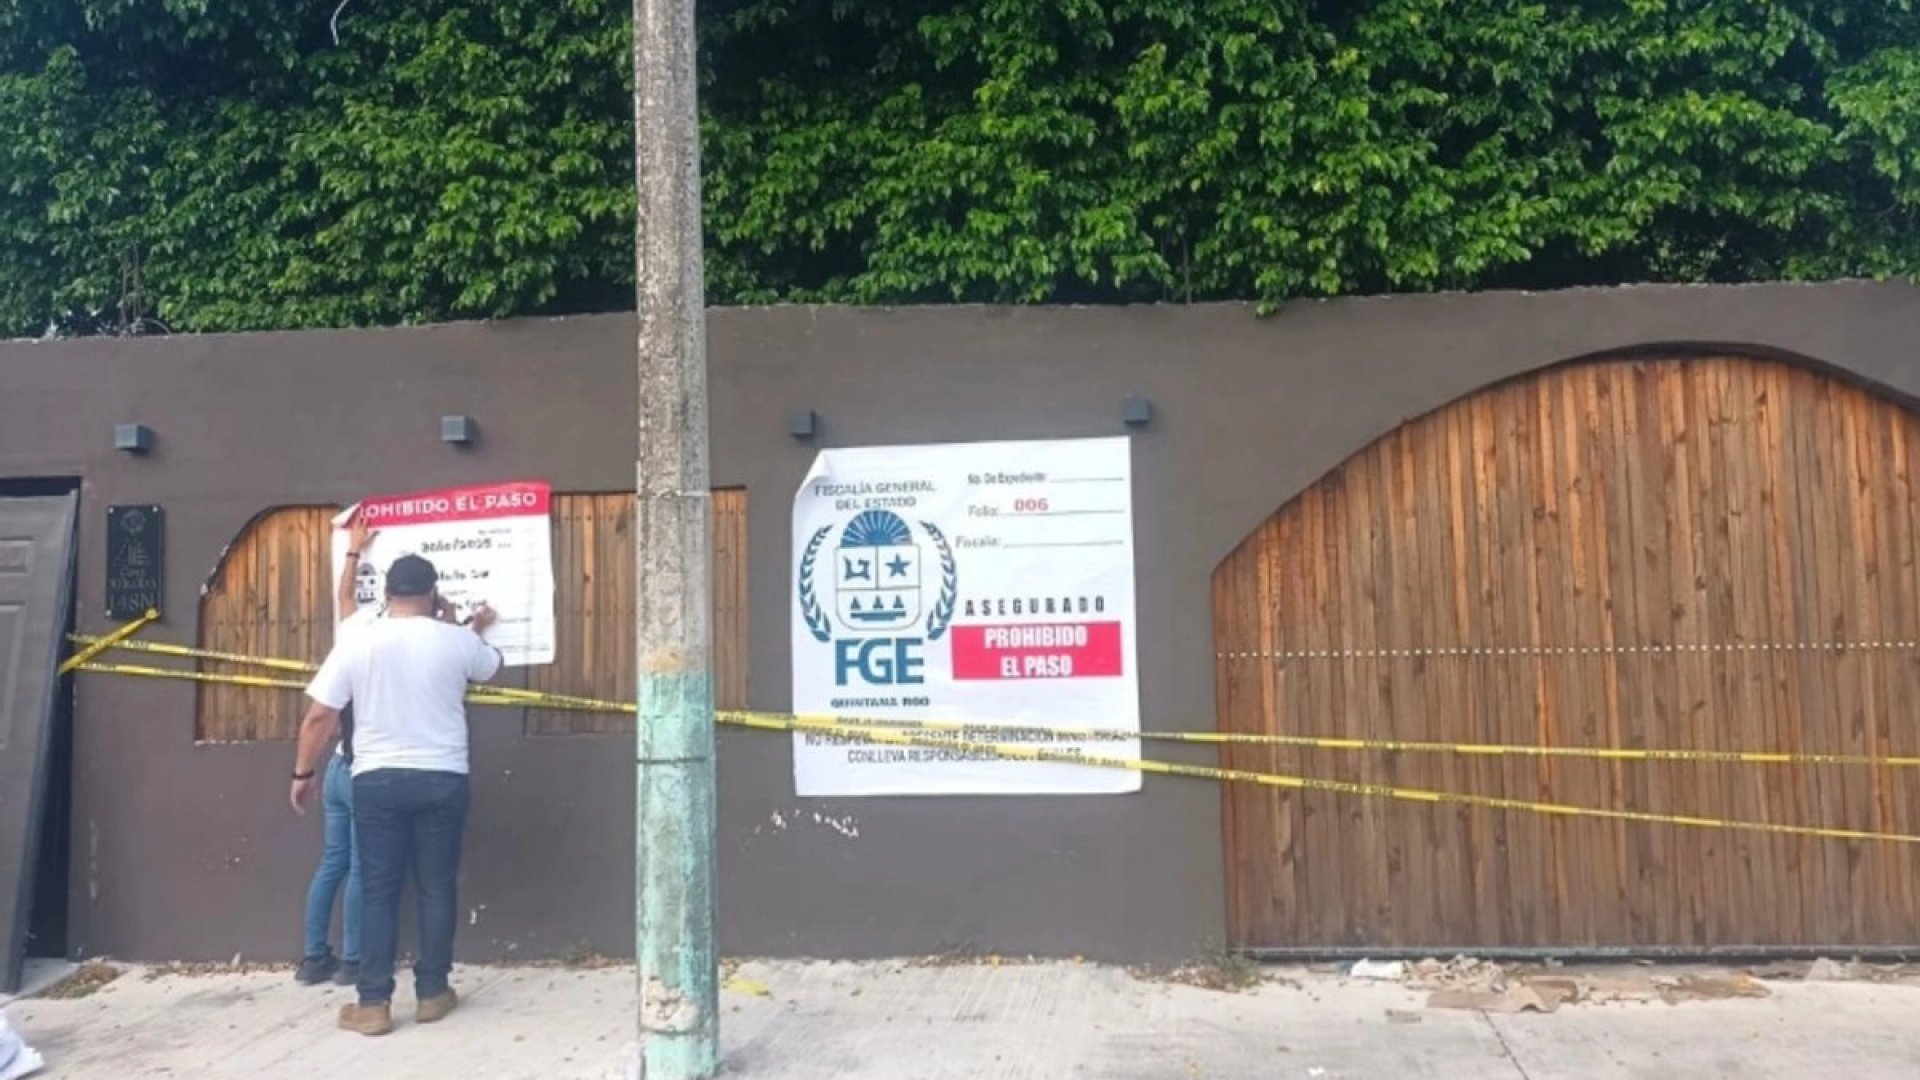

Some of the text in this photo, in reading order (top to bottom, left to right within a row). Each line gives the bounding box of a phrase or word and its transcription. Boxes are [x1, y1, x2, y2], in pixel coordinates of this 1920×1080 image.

[875, 479, 936, 494] GENERAL
[456, 496, 477, 511] EL
[485, 492, 537, 508] PASO
[836, 497, 917, 511] DEL ESTADO
[1014, 498, 1049, 512] 006
[965, 596, 1106, 617] ASEGURADO
[985, 625, 1087, 649] PROHIBIDO
[835, 637, 924, 686] FGE
[1002, 655, 1073, 677] EL PASO
[848, 749, 906, 764] CONLLEVA
